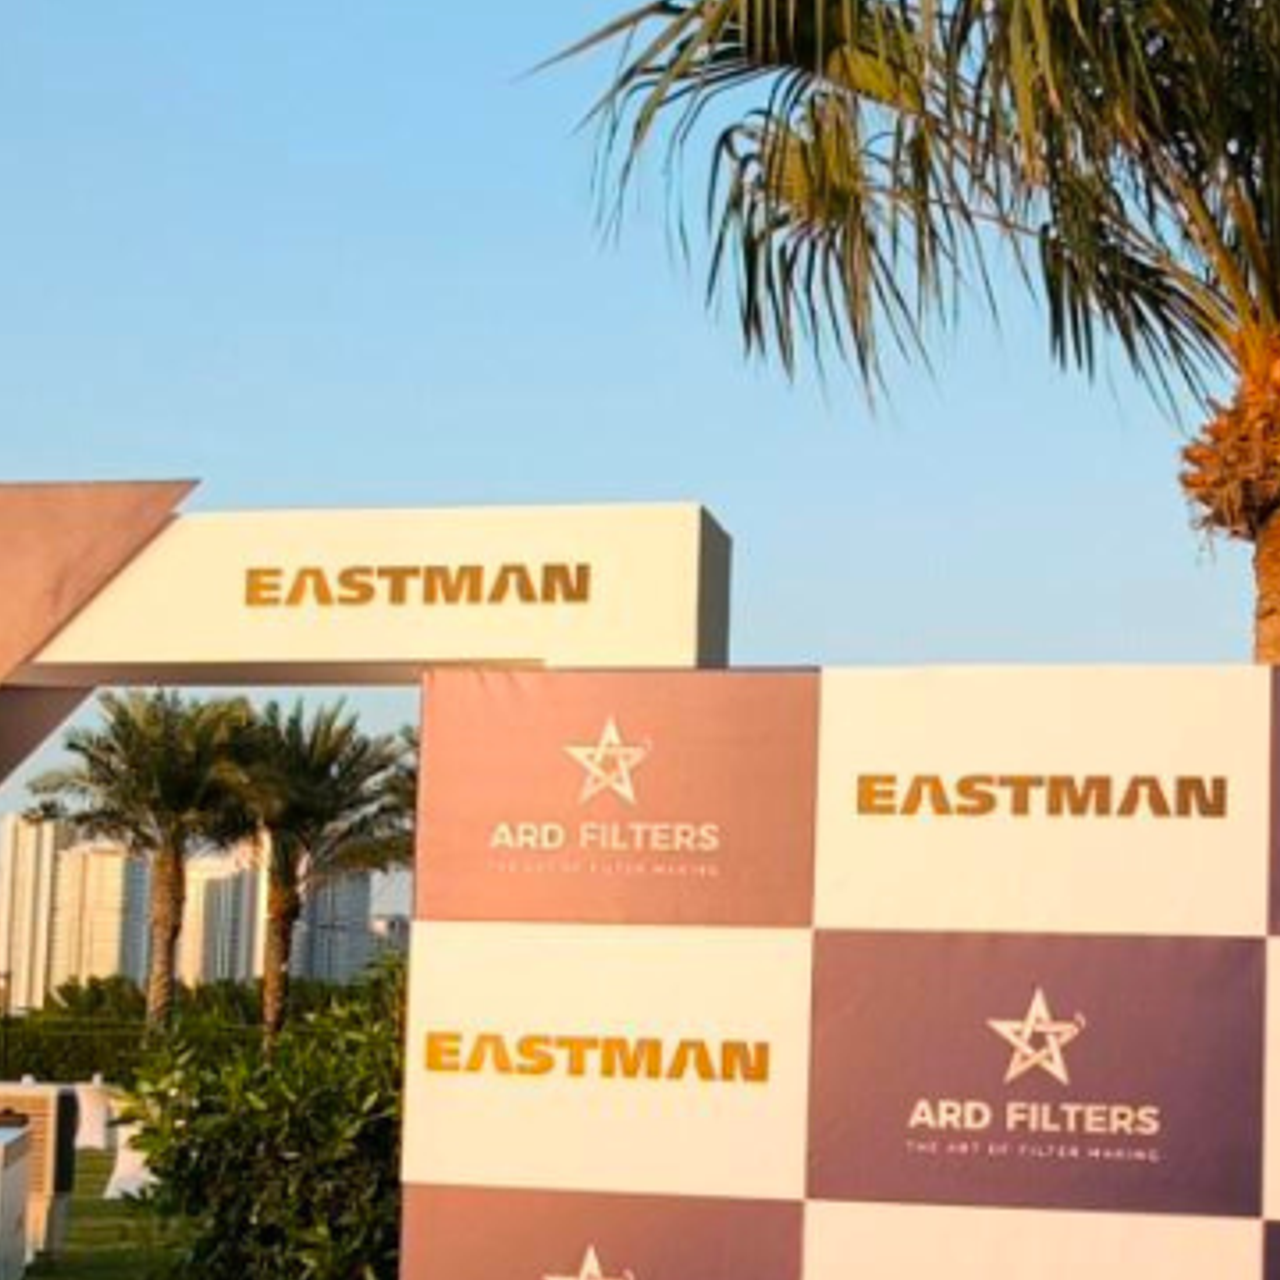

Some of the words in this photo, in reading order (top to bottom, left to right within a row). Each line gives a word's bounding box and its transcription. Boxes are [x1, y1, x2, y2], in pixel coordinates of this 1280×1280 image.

[246, 563, 590, 606] EASTMAN
[857, 775, 1227, 818] EASTMAN
[490, 823, 565, 849] ARD
[580, 823, 720, 851] FILTERS
[425, 1032, 770, 1083] EASTMAN
[909, 1099, 992, 1130] ARD
[1006, 1101, 1160, 1134] FILTERS
